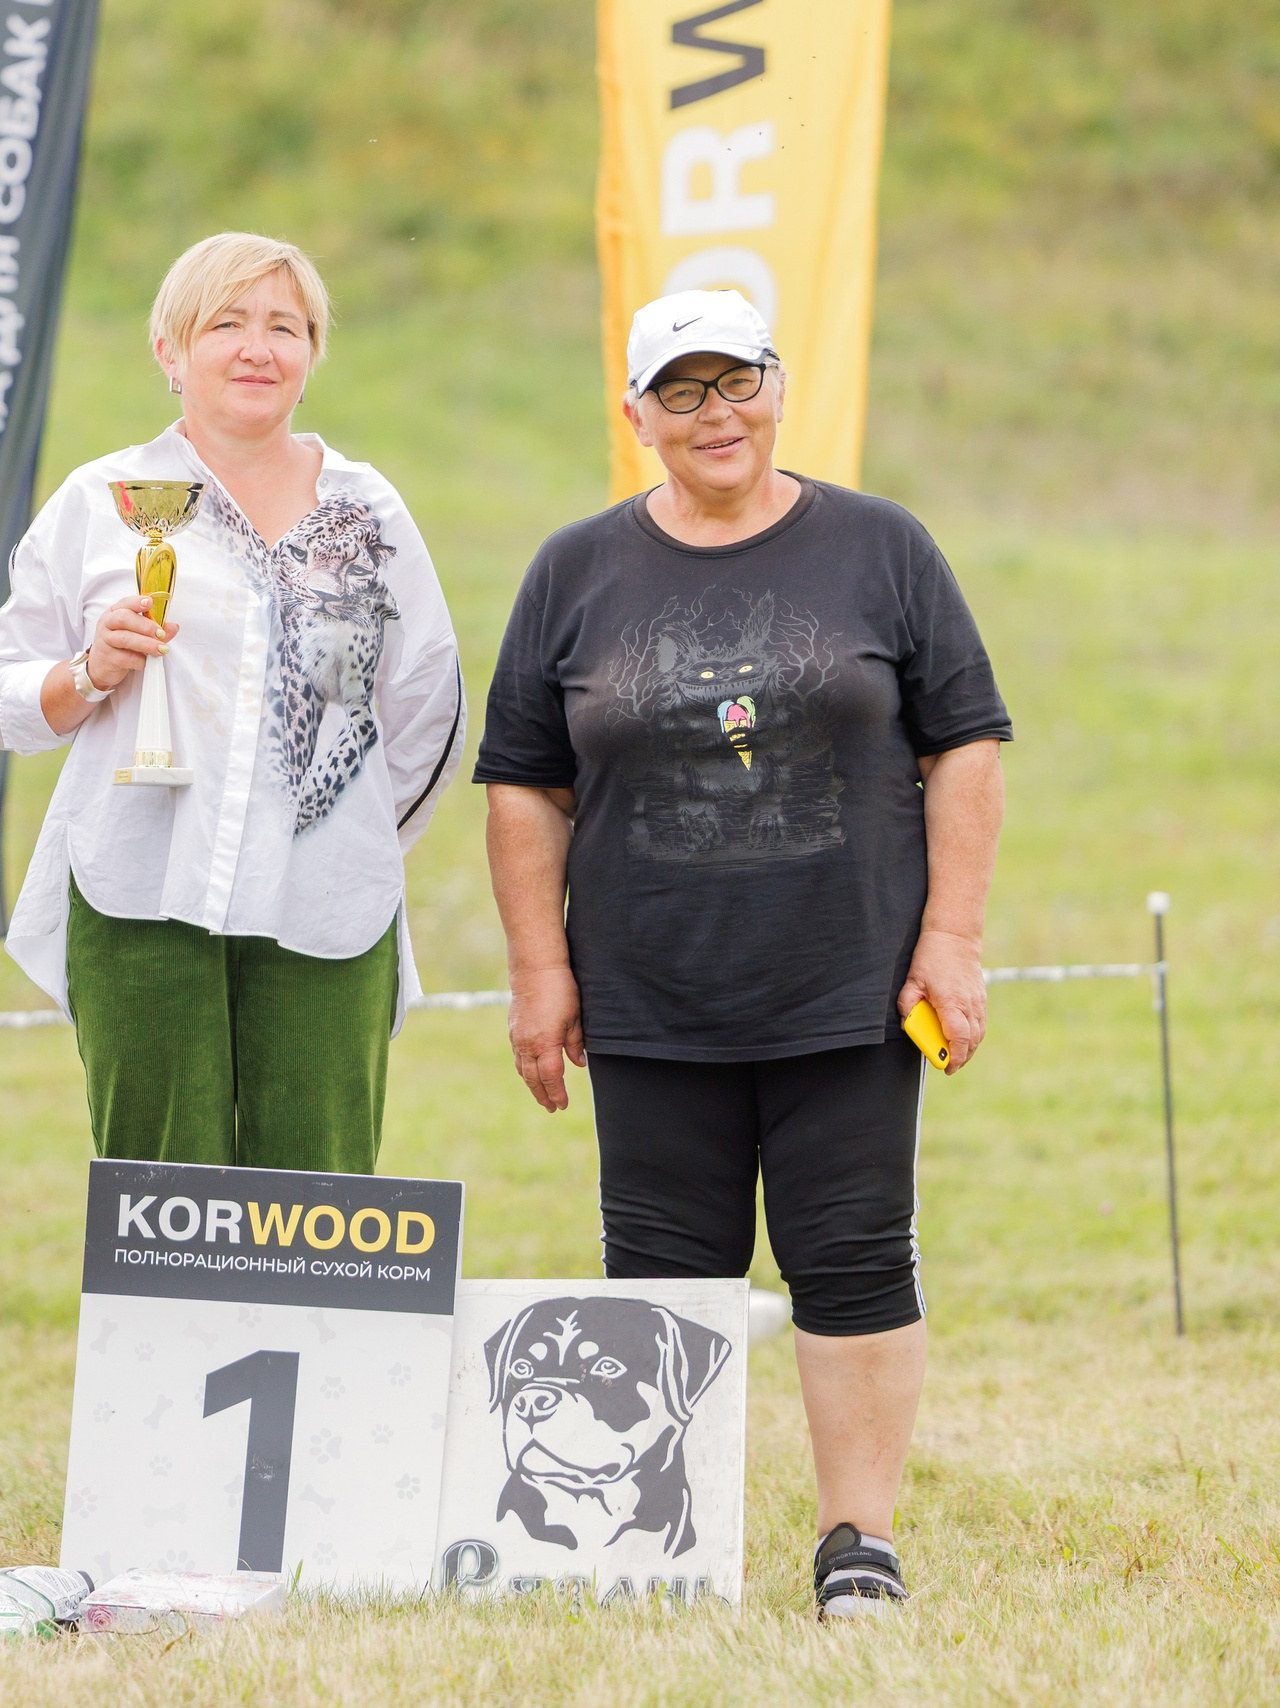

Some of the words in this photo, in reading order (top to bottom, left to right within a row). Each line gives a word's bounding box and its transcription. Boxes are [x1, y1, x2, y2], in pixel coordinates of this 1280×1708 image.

[117, 1193, 436, 1255] KORWOOD
[114, 1248, 306, 1275] ПОЛНОРАЦИОННЫЙ
[310, 1257, 372, 1279] СУХОЙ
[377, 1264, 431, 1281] КОРМ
[203, 1349, 300, 1573] 1
